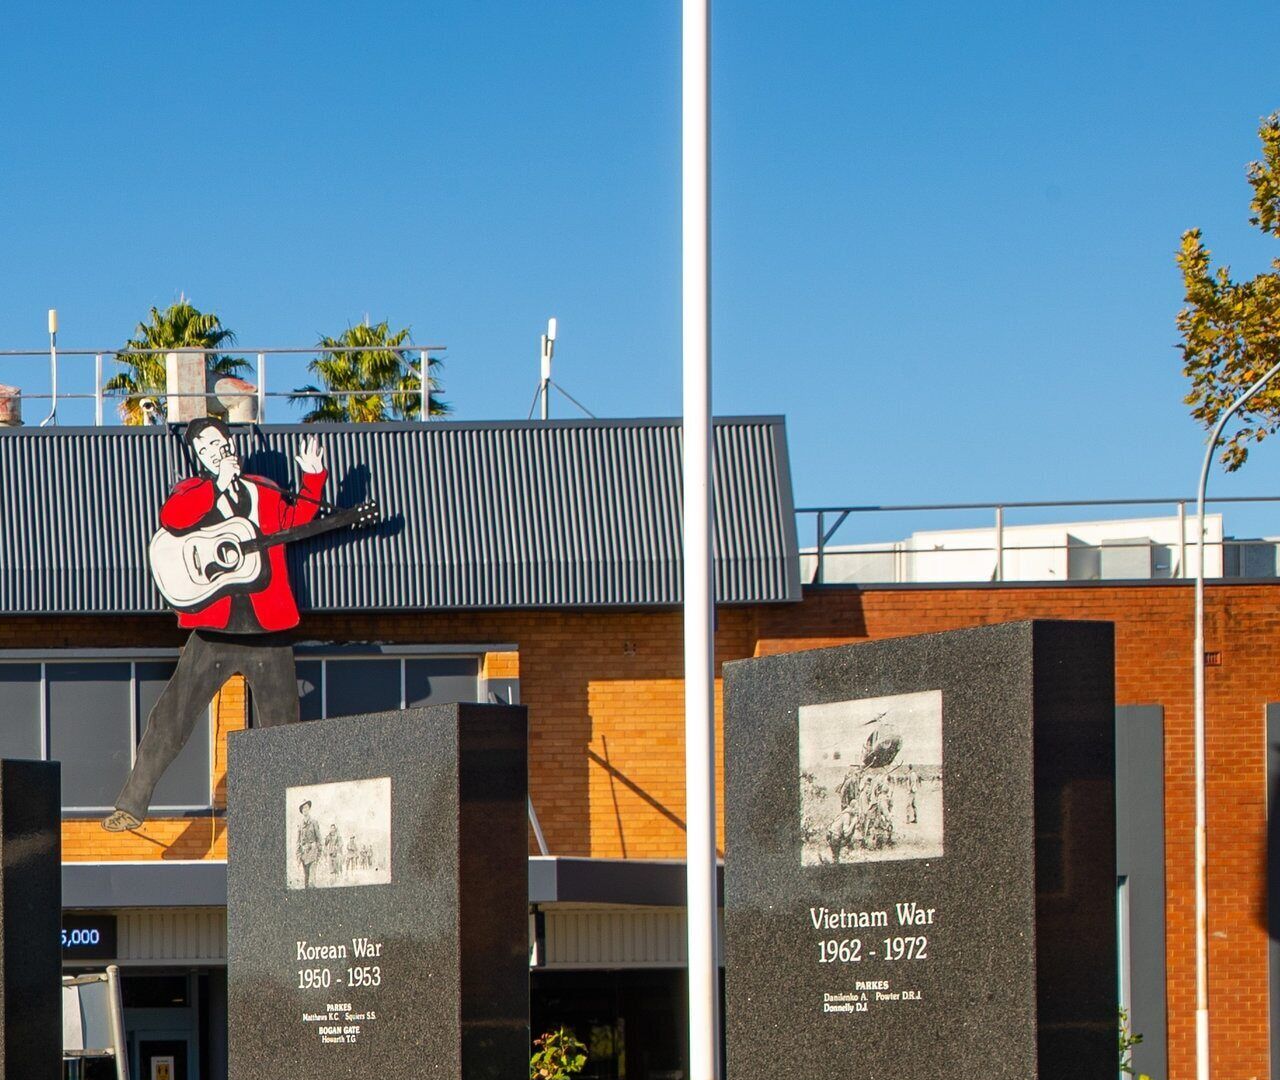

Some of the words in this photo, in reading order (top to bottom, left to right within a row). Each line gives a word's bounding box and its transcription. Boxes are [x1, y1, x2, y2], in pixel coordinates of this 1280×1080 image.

[810, 907, 888, 929] Vietnam
[896, 902, 935, 926] War
[296, 941, 347, 960] Korean
[352, 938, 382, 957] War
[818, 938, 862, 963] 1962
[884, 936, 927, 960] 1972
[298, 968, 331, 989] 1950
[347, 966, 381, 987] 1953
[855, 981, 889, 991] PARKES
[326, 1003, 352, 1012] PARKES
[319, 1026, 342, 1035] BOGAN
[343, 1025, 361, 1034] GATE
